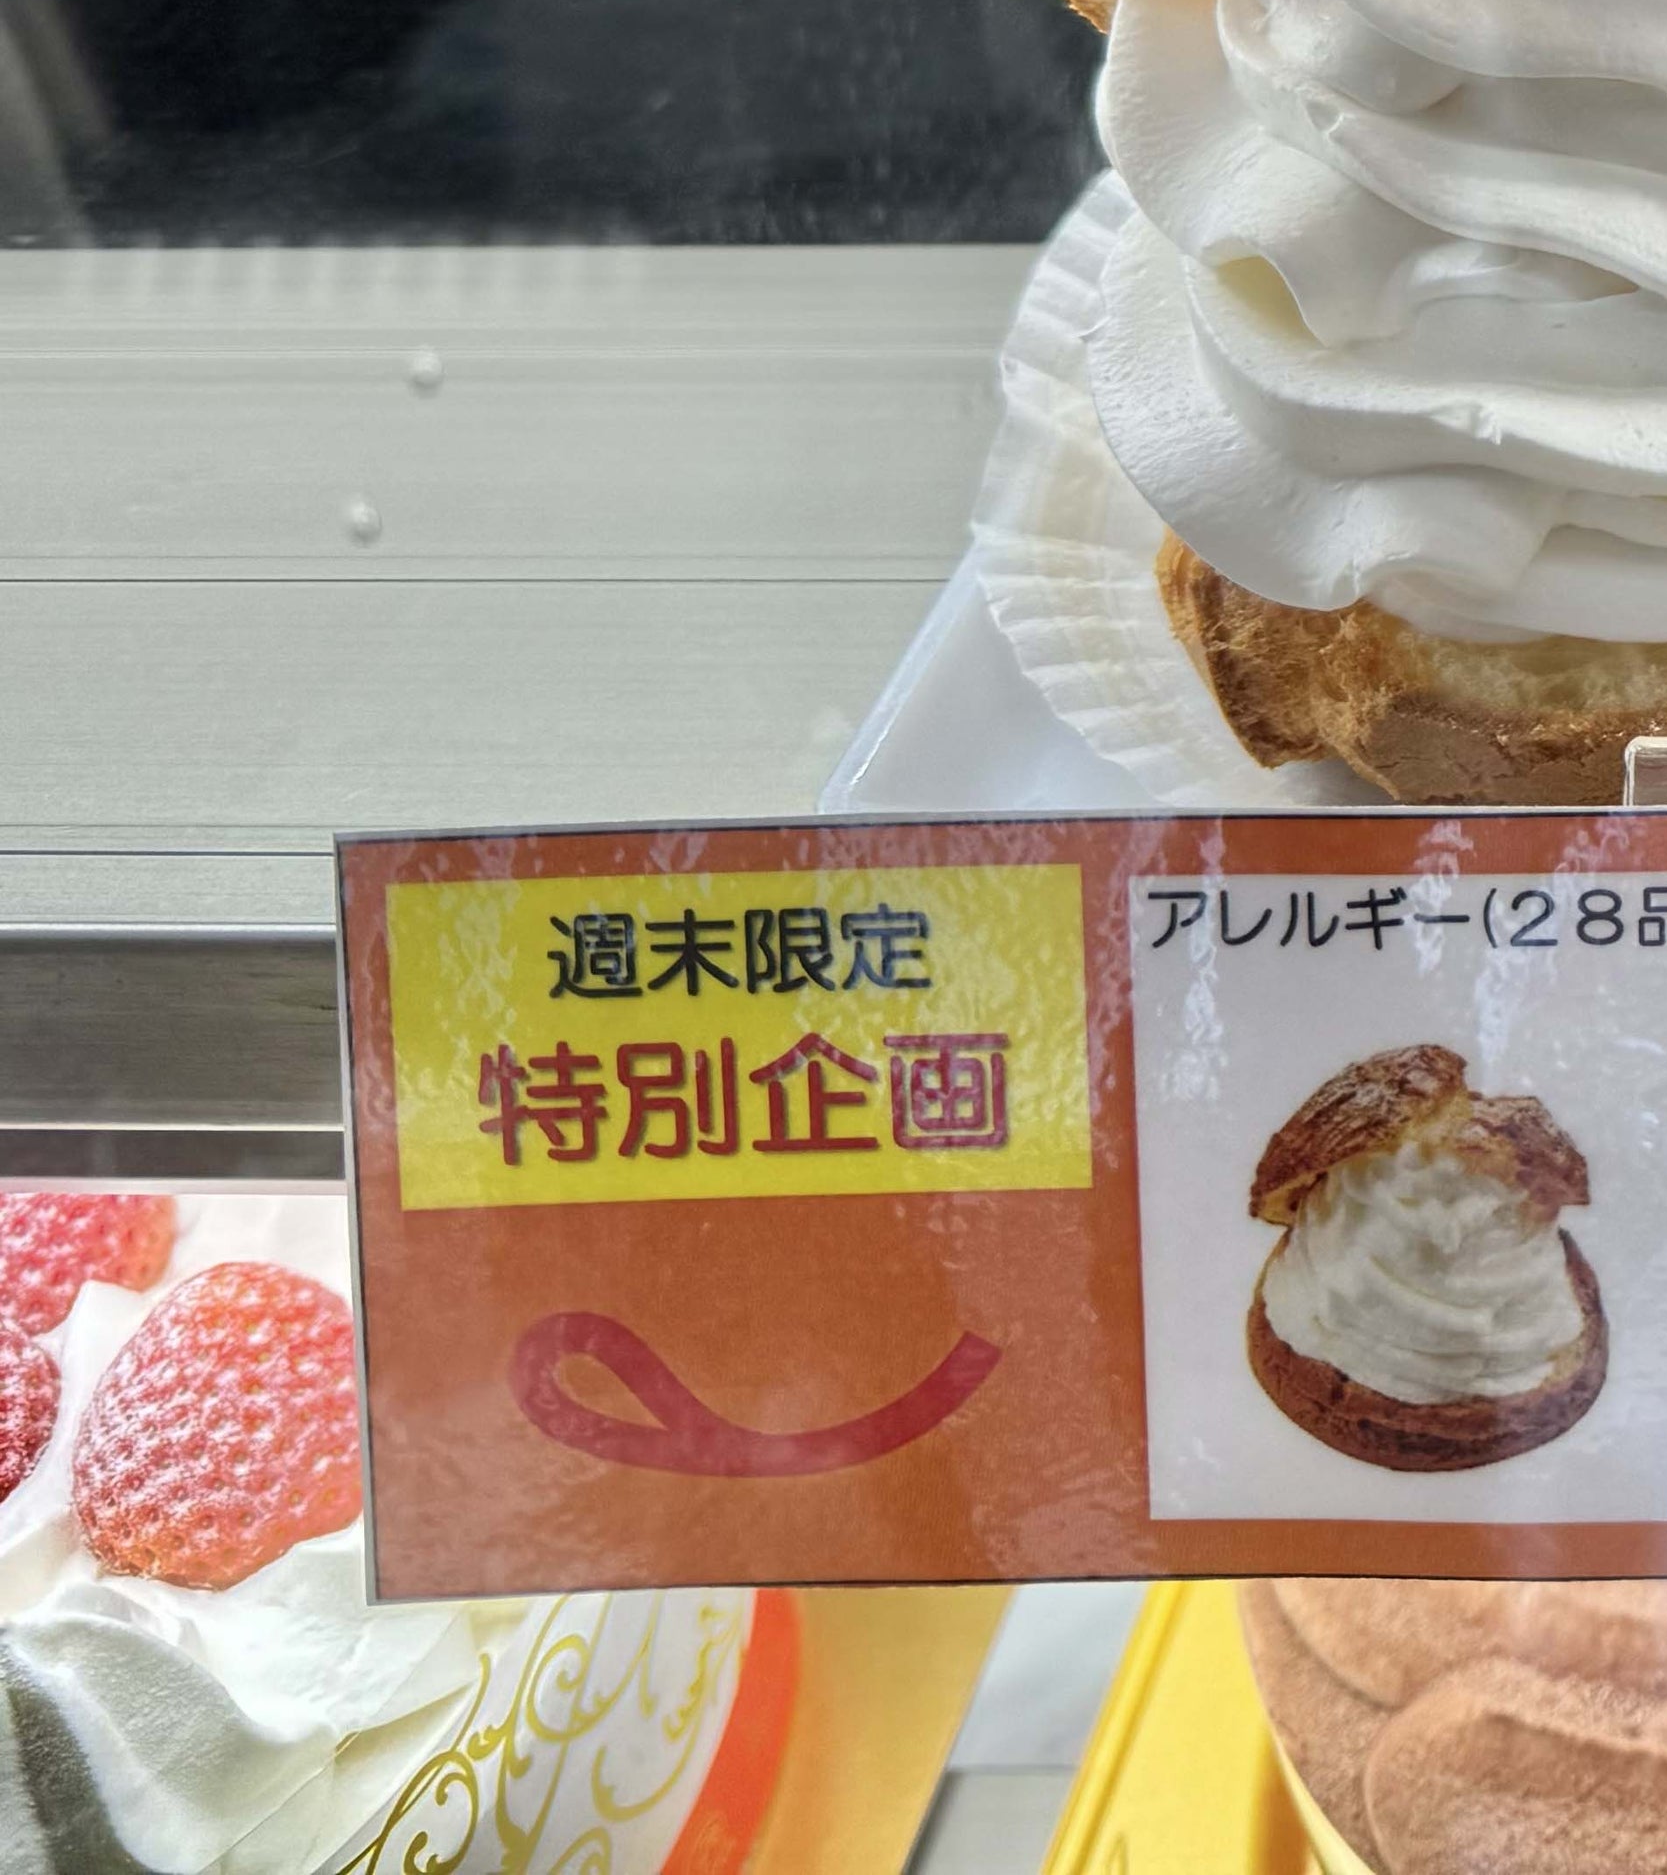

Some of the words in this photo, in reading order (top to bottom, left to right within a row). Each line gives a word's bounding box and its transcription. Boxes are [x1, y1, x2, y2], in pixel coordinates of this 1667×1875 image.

[547, 903, 932, 1000] 週末限定
[478, 1032, 1010, 1166] 特別企画
